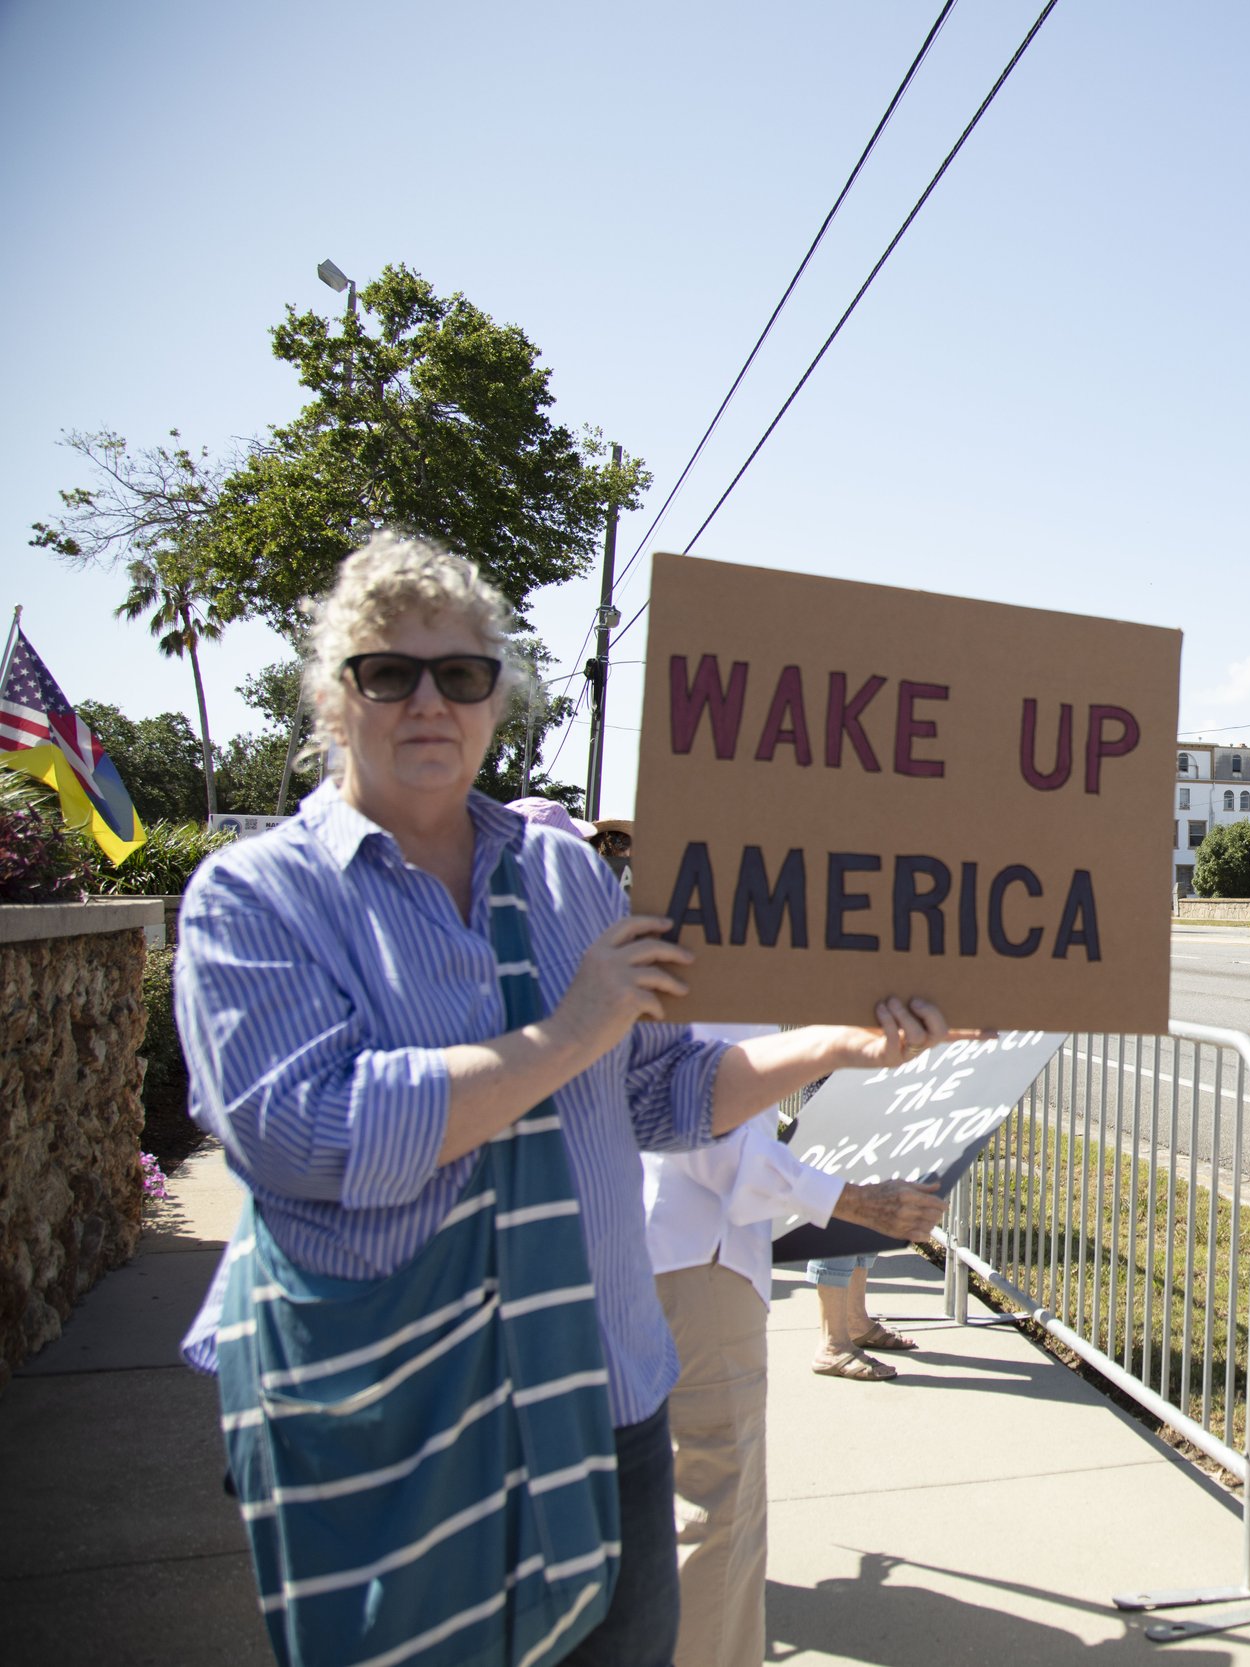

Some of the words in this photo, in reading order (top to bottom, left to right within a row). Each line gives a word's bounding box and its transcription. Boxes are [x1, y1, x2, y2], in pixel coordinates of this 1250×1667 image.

[669, 654, 949, 778] WAKE
[1020, 697, 1140, 795] UP
[661, 841, 1102, 962] AMERICA
